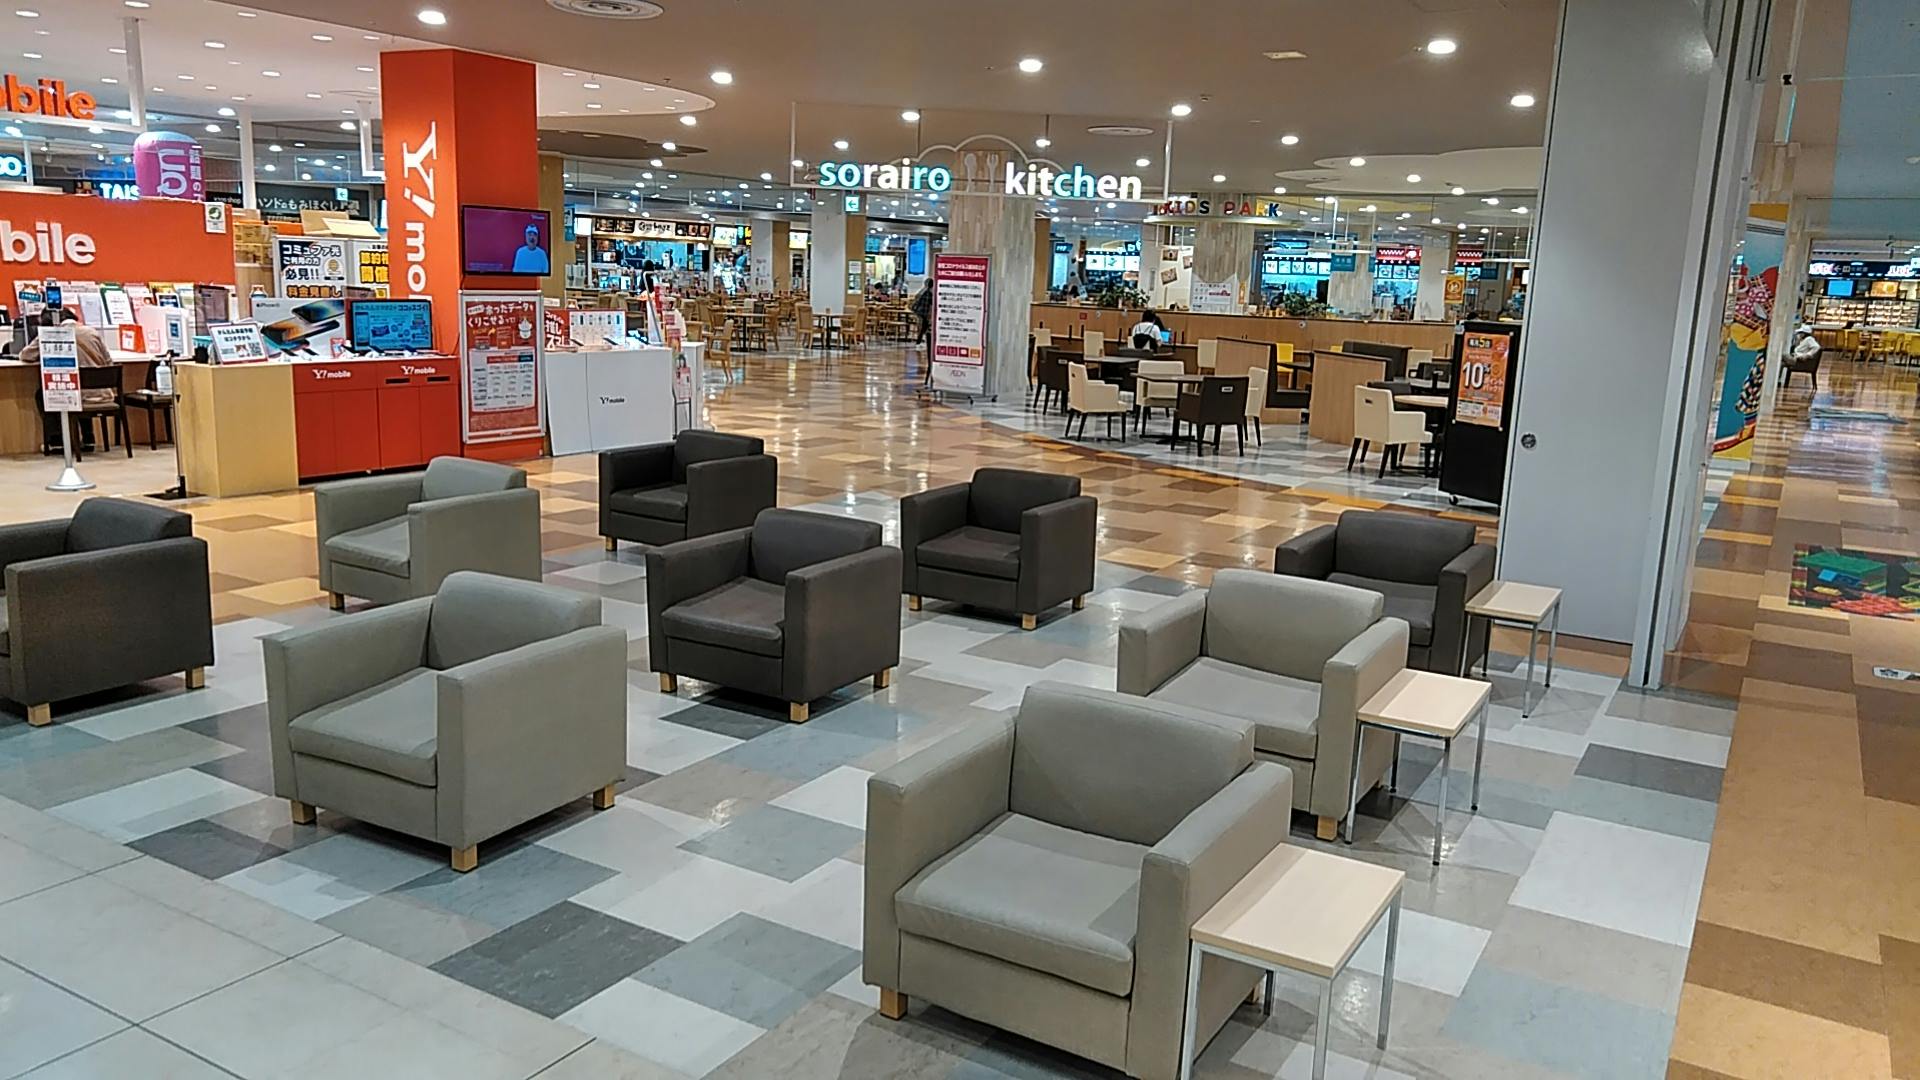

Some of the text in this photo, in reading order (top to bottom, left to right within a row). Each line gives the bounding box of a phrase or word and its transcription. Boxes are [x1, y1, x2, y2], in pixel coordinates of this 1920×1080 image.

[0, 73, 97, 119] bile
[819, 157, 1142, 200] sorairo kitchen
[1224, 201, 1280, 217] PARK
[282, 244, 342, 257] コミュファ光
